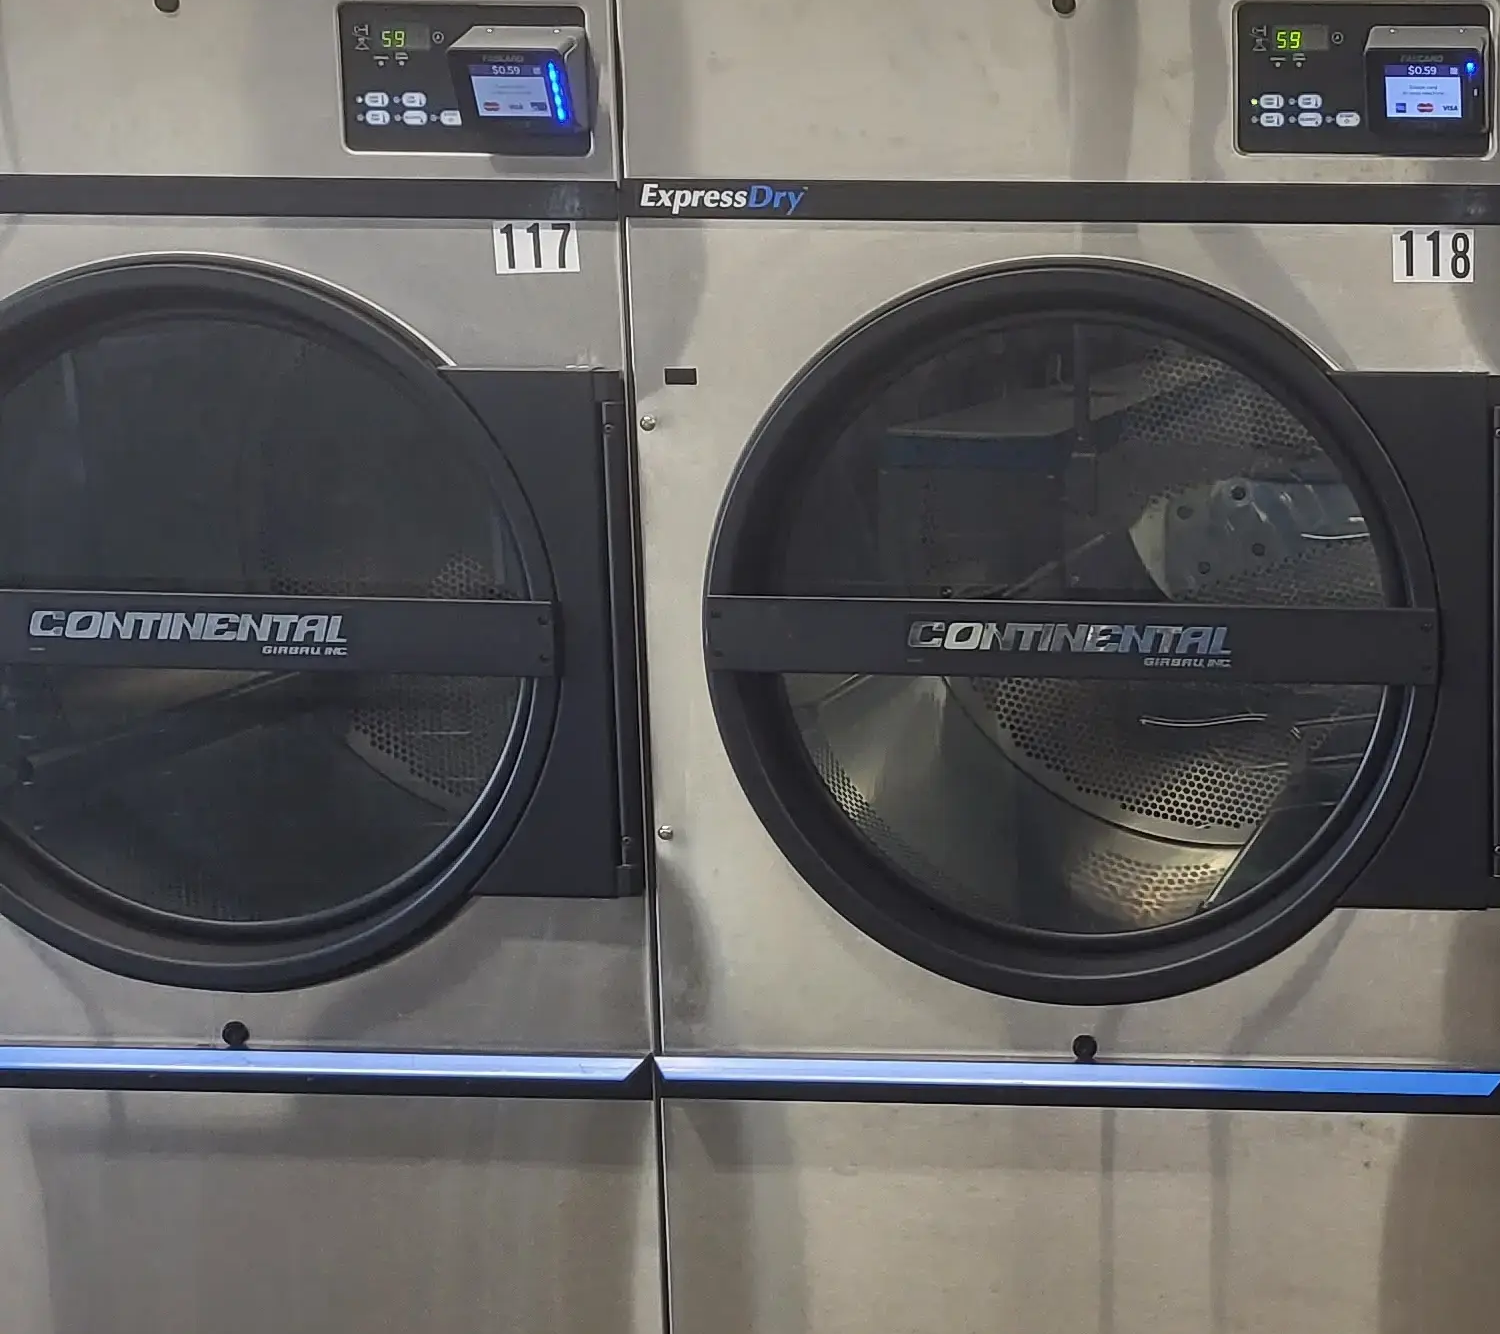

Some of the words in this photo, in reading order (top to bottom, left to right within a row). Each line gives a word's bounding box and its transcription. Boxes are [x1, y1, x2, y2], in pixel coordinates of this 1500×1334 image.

[381, 30, 406, 47] 59
[1276, 31, 1302, 48] 59
[491, 65, 520, 75] $0.59
[1407, 65, 1437, 76] $0.59
[640, 183, 804, 215] ExpressDry
[500, 223, 571, 270] 117
[1399, 230, 1471, 279] 118
[29, 610, 348, 644] CONTINENTAL
[907, 621, 1233, 656] CONTINENTAL
